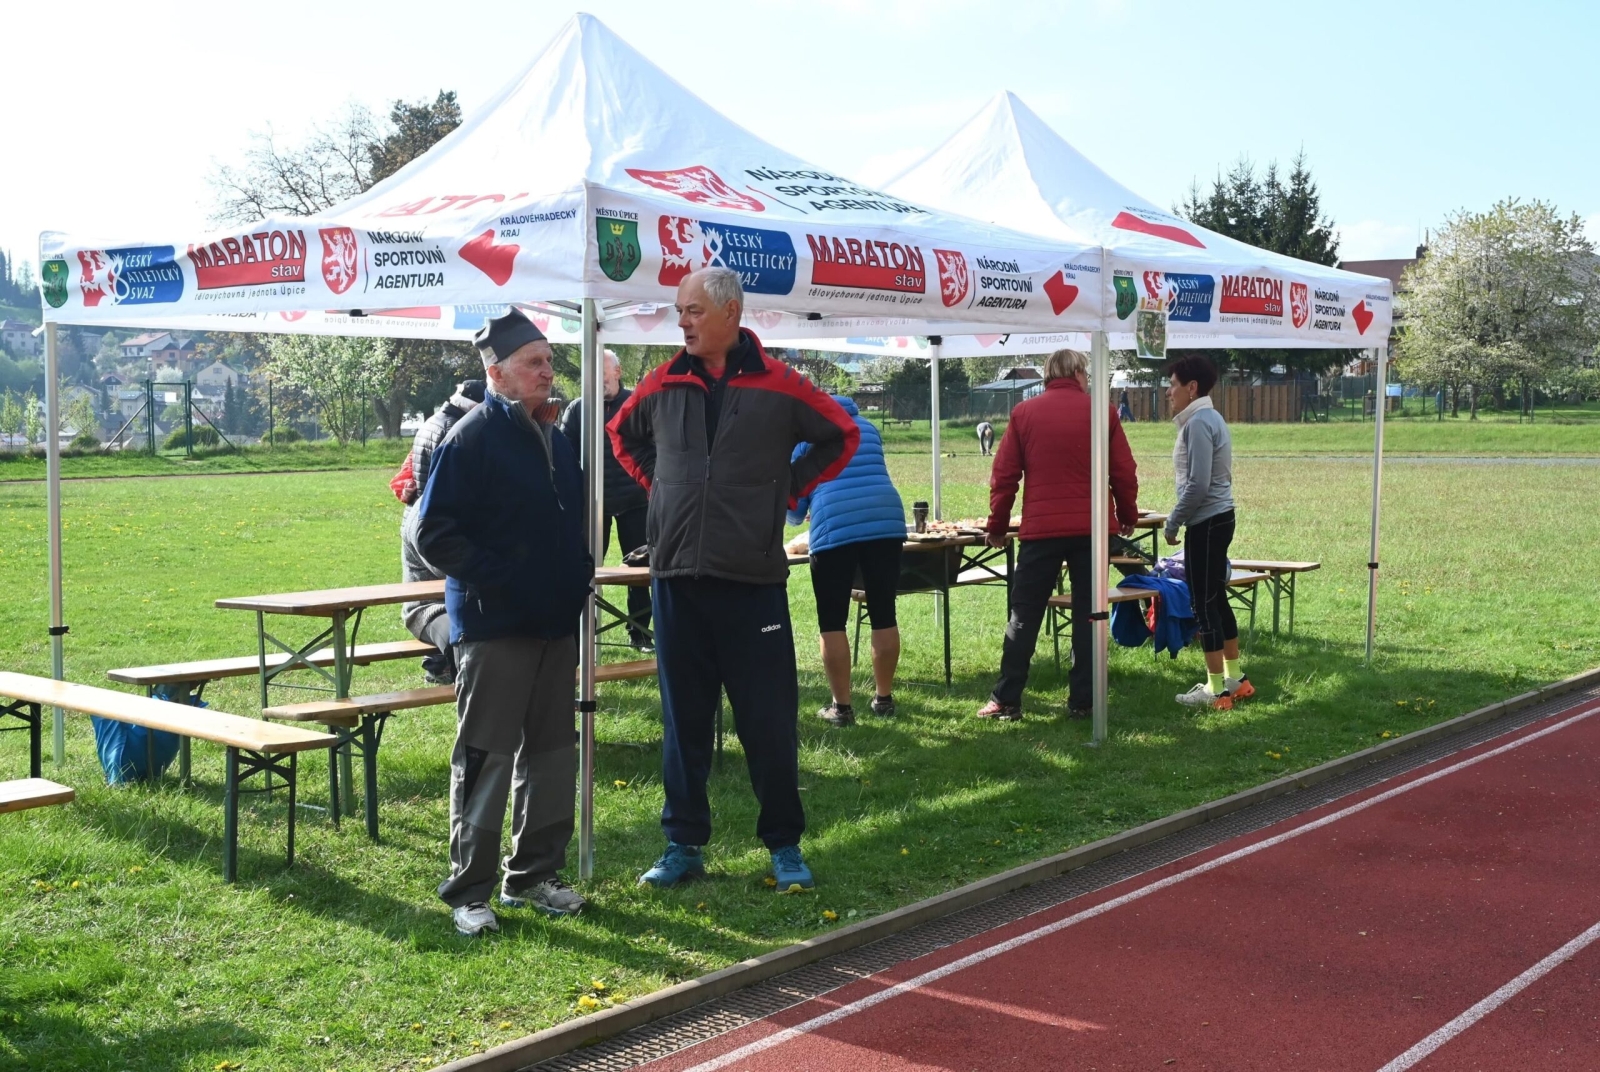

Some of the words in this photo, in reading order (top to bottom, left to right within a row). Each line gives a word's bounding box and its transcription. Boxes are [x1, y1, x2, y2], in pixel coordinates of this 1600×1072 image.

[500, 208, 577, 226] KRÁLOVÉHRADECKÝ
[596, 207, 618, 218] MĚSTO
[619, 210, 638, 220] ÚPICE
[367, 226, 428, 244] NÁRODNÍ
[500, 229, 520, 238] KRAJ
[725, 228, 763, 249] ČESKÝ
[187, 230, 307, 268] MARATON
[374, 245, 446, 267] SPORTOVNÍ
[806, 233, 925, 272] MARATON
[125, 251, 152, 268] ČESKÝ
[729, 251, 793, 270] ATLETICKÝ
[976, 255, 1020, 273] NÁRODNÍ
[127, 265, 180, 283] ATLETICKÝ
[271, 264, 301, 278] stav
[737, 271, 760, 286] VAZ
[374, 272, 444, 289] AGENTURA
[895, 273, 922, 288] stav
[981, 276, 1032, 293] SPORTOVNÍ
[1178, 277, 1199, 289] ČESKÝ
[1221, 274, 1283, 300] MARATON
[130, 286, 155, 300] SVAZ
[248, 287, 277, 299] jednota
[280, 285, 306, 296] Úpice
[808, 288, 865, 299] tělovýchovná
[866, 293, 897, 302] jednota
[900, 294, 923, 304] Úpice
[1180, 291, 1213, 304] ATLETICKÝ
[1314, 288, 1339, 302] NÁRODNÍ
[977, 296, 1027, 309] AGENTURA
[1264, 303, 1281, 312] stav
[1175, 305, 1193, 317] SVAZ
[1315, 305, 1345, 317] SPORTOVNÍ
[1313, 319, 1341, 331] AGENTURA
[761, 623, 781, 633] adidas
